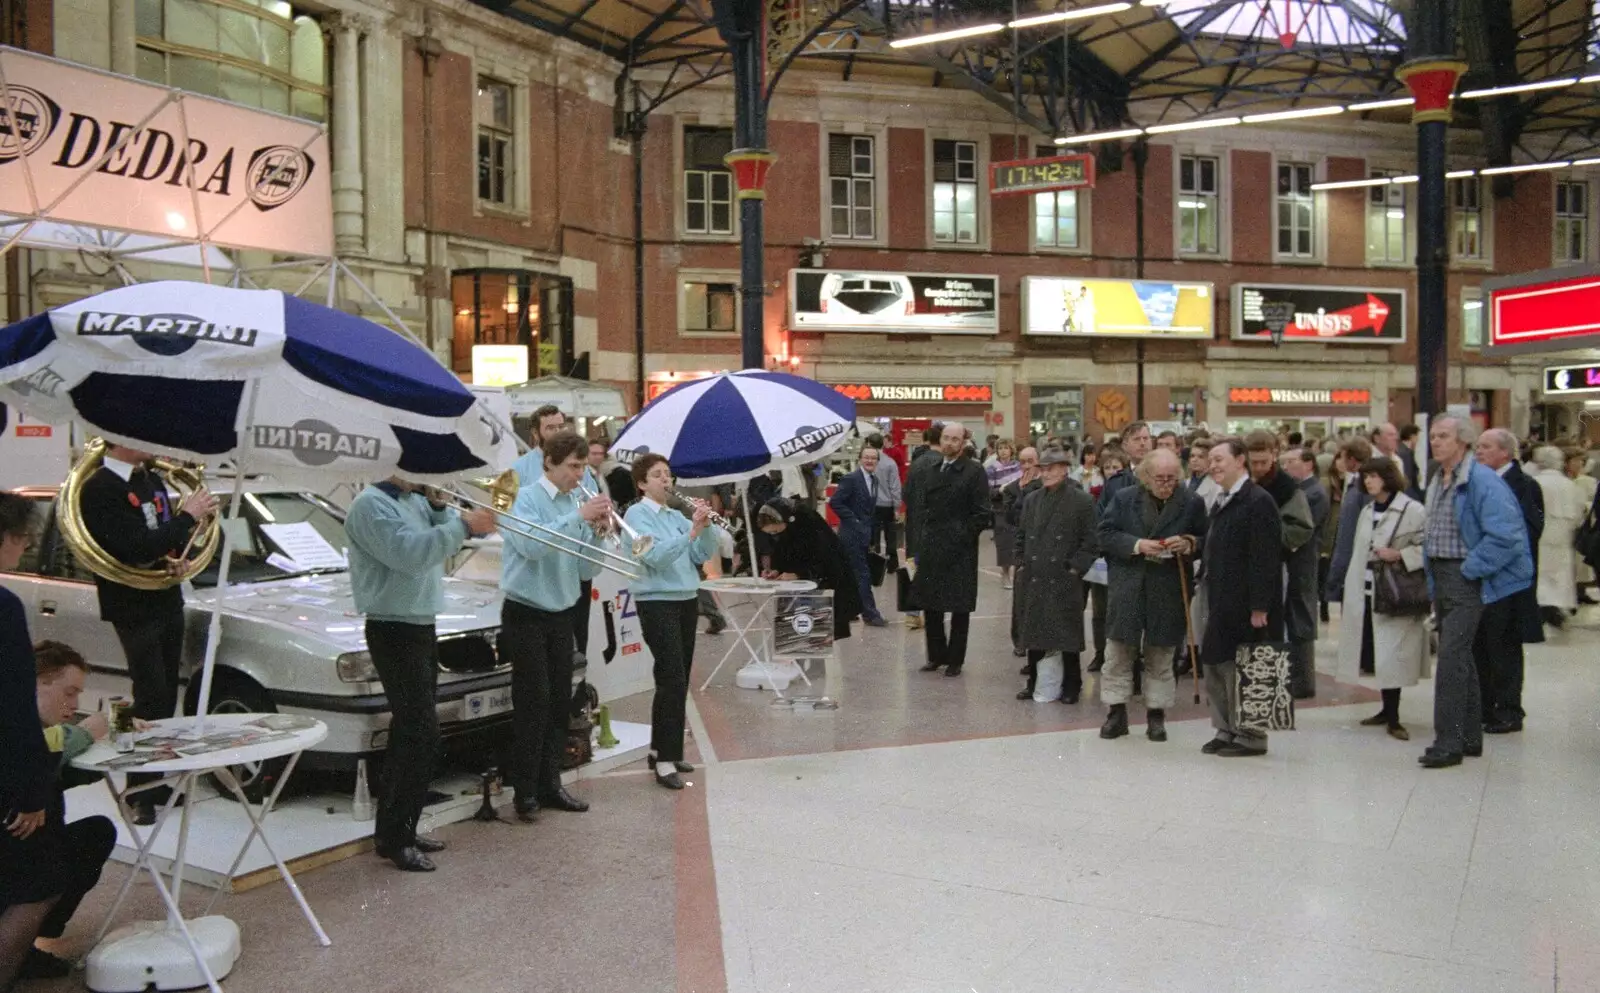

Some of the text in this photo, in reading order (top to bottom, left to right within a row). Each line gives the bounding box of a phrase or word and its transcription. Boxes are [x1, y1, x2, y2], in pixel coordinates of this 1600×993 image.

[52, 112, 235, 196] DEDRA
[83, 313, 253, 343] MARTINI
[870, 386, 943, 400] WHSMITH
[1270, 389, 1331, 403] WHSMITH
[781, 423, 843, 455] MARTINI
